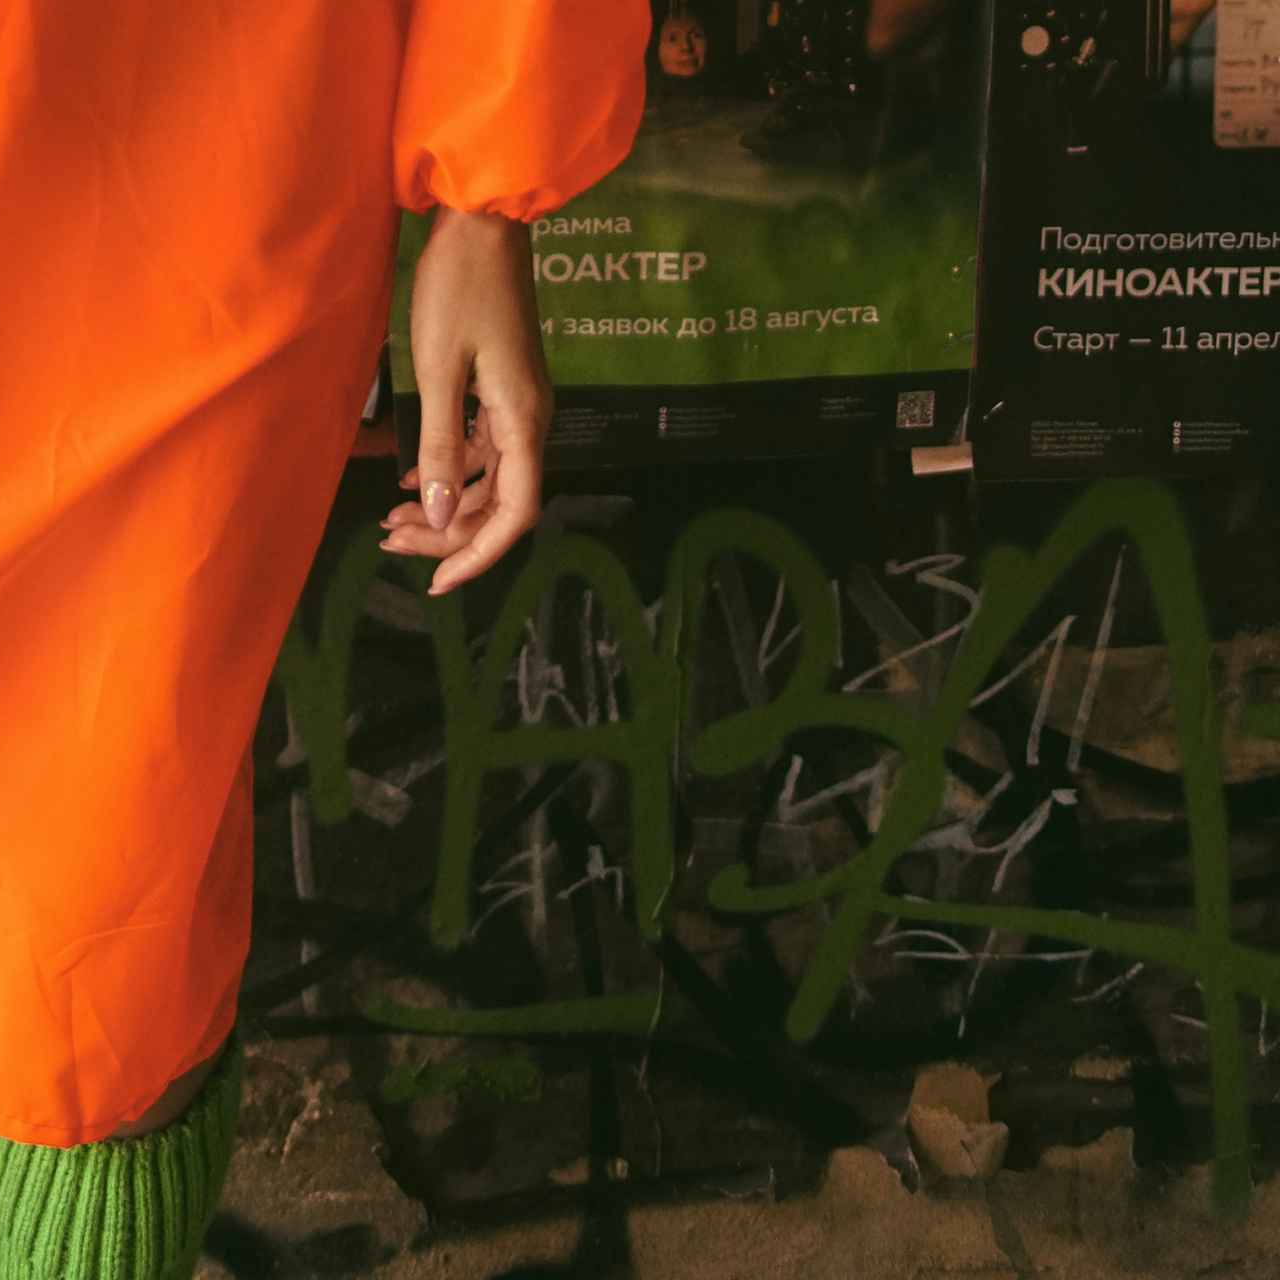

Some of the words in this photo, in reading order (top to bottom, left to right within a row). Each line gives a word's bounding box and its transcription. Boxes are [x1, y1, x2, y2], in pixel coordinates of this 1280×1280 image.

[1037, 266, 1280, 298] КИНОАКТЕР
[562, 317, 670, 337] заявок
[676, 316, 717, 340] до
[724, 307, 759, 332] 18
[765, 303, 880, 333] августа
[1033, 325, 1121, 356] Старт
[1160, 325, 1189, 350] 11
